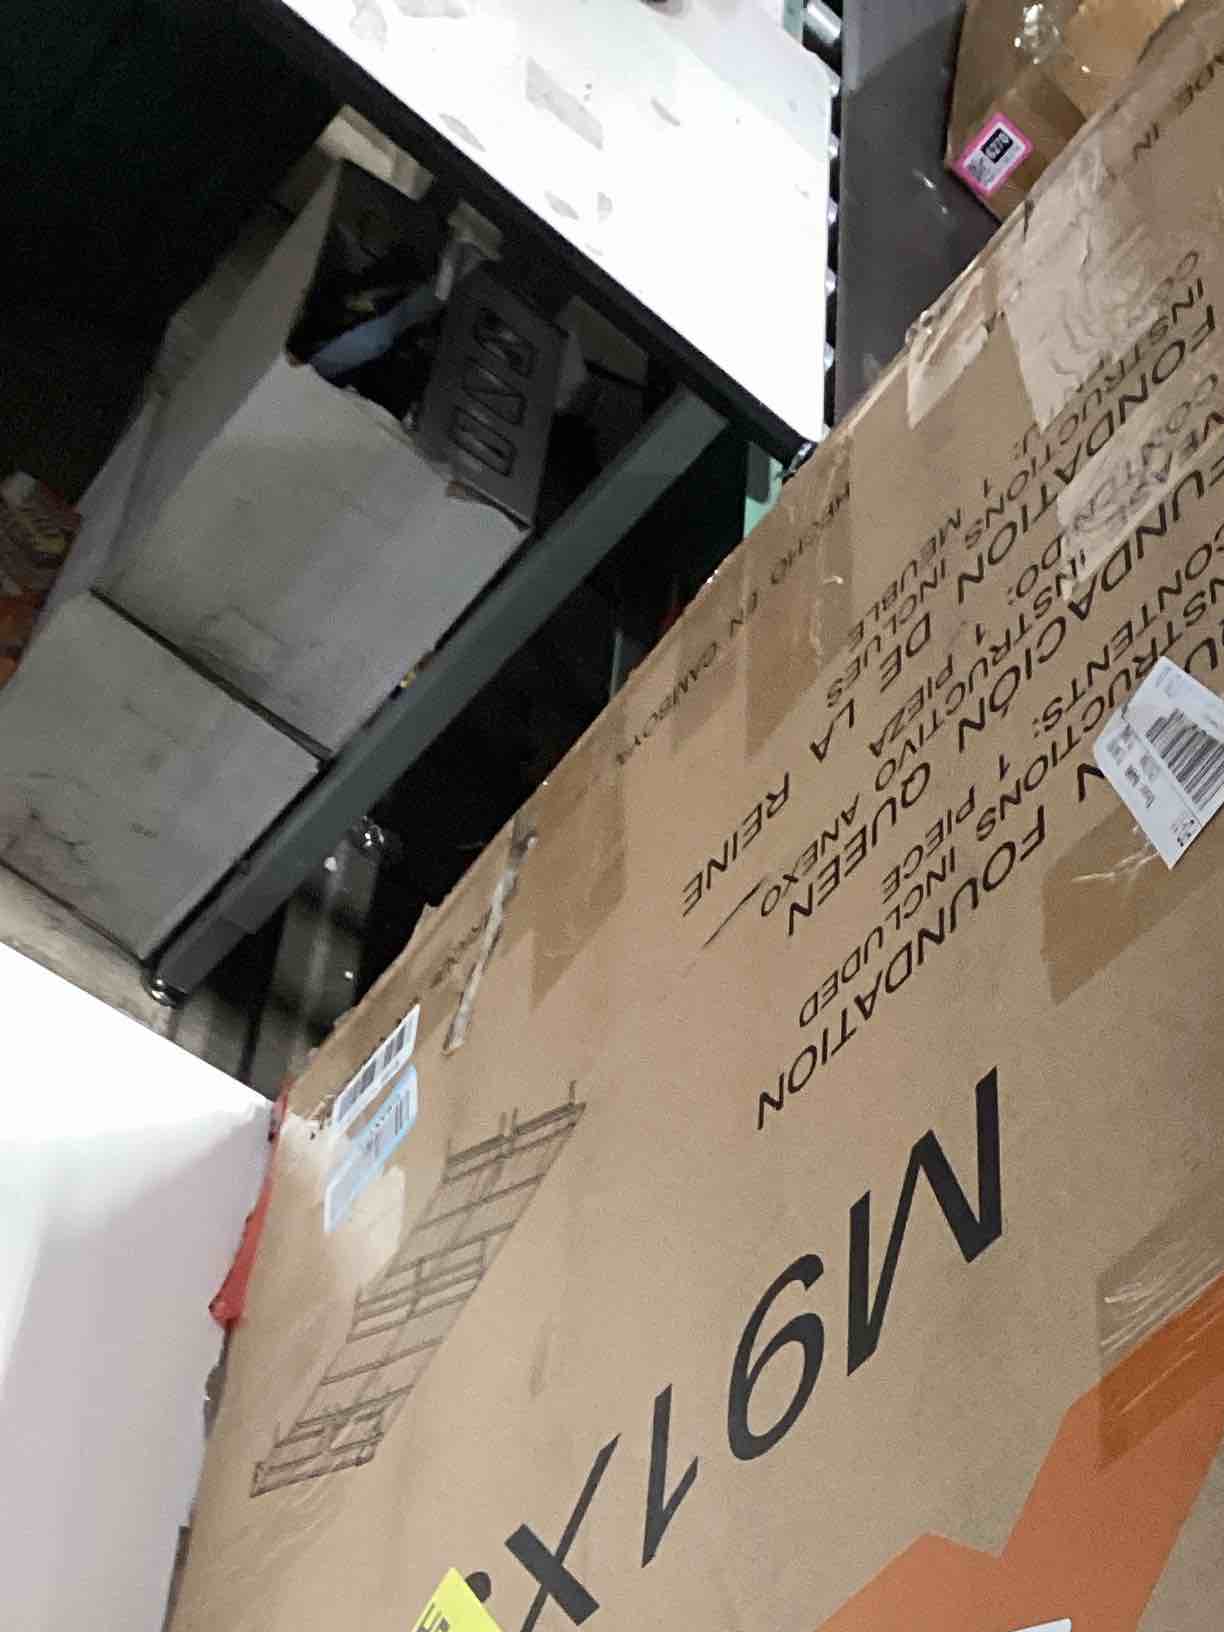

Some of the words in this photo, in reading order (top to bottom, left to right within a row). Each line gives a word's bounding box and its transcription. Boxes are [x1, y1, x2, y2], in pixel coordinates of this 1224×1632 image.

[1132, 121, 1160, 160] IN
[953, 300, 1215, 605] FONDATION
[963, 274, 1202, 551] INSTRUCTIONS
[826, 558, 946, 711] INCLUES
[849, 508, 958, 652] MEUBLE
[878, 610, 930, 690] DE
[809, 699, 855, 766] LA
[867, 652, 953, 763] PIEZA
[873, 547, 1089, 795] INSTRUCTIVO
[994, 749, 1011, 780] 1
[679, 772, 791, 917] REINE
[760, 793, 858, 921] ANEXO
[783, 757, 933, 938] QUEEN
[880, 783, 977, 904] PIECE
[752, 804, 1048, 1131] FOUNDATION
[796, 845, 958, 1030] INCLUDED
